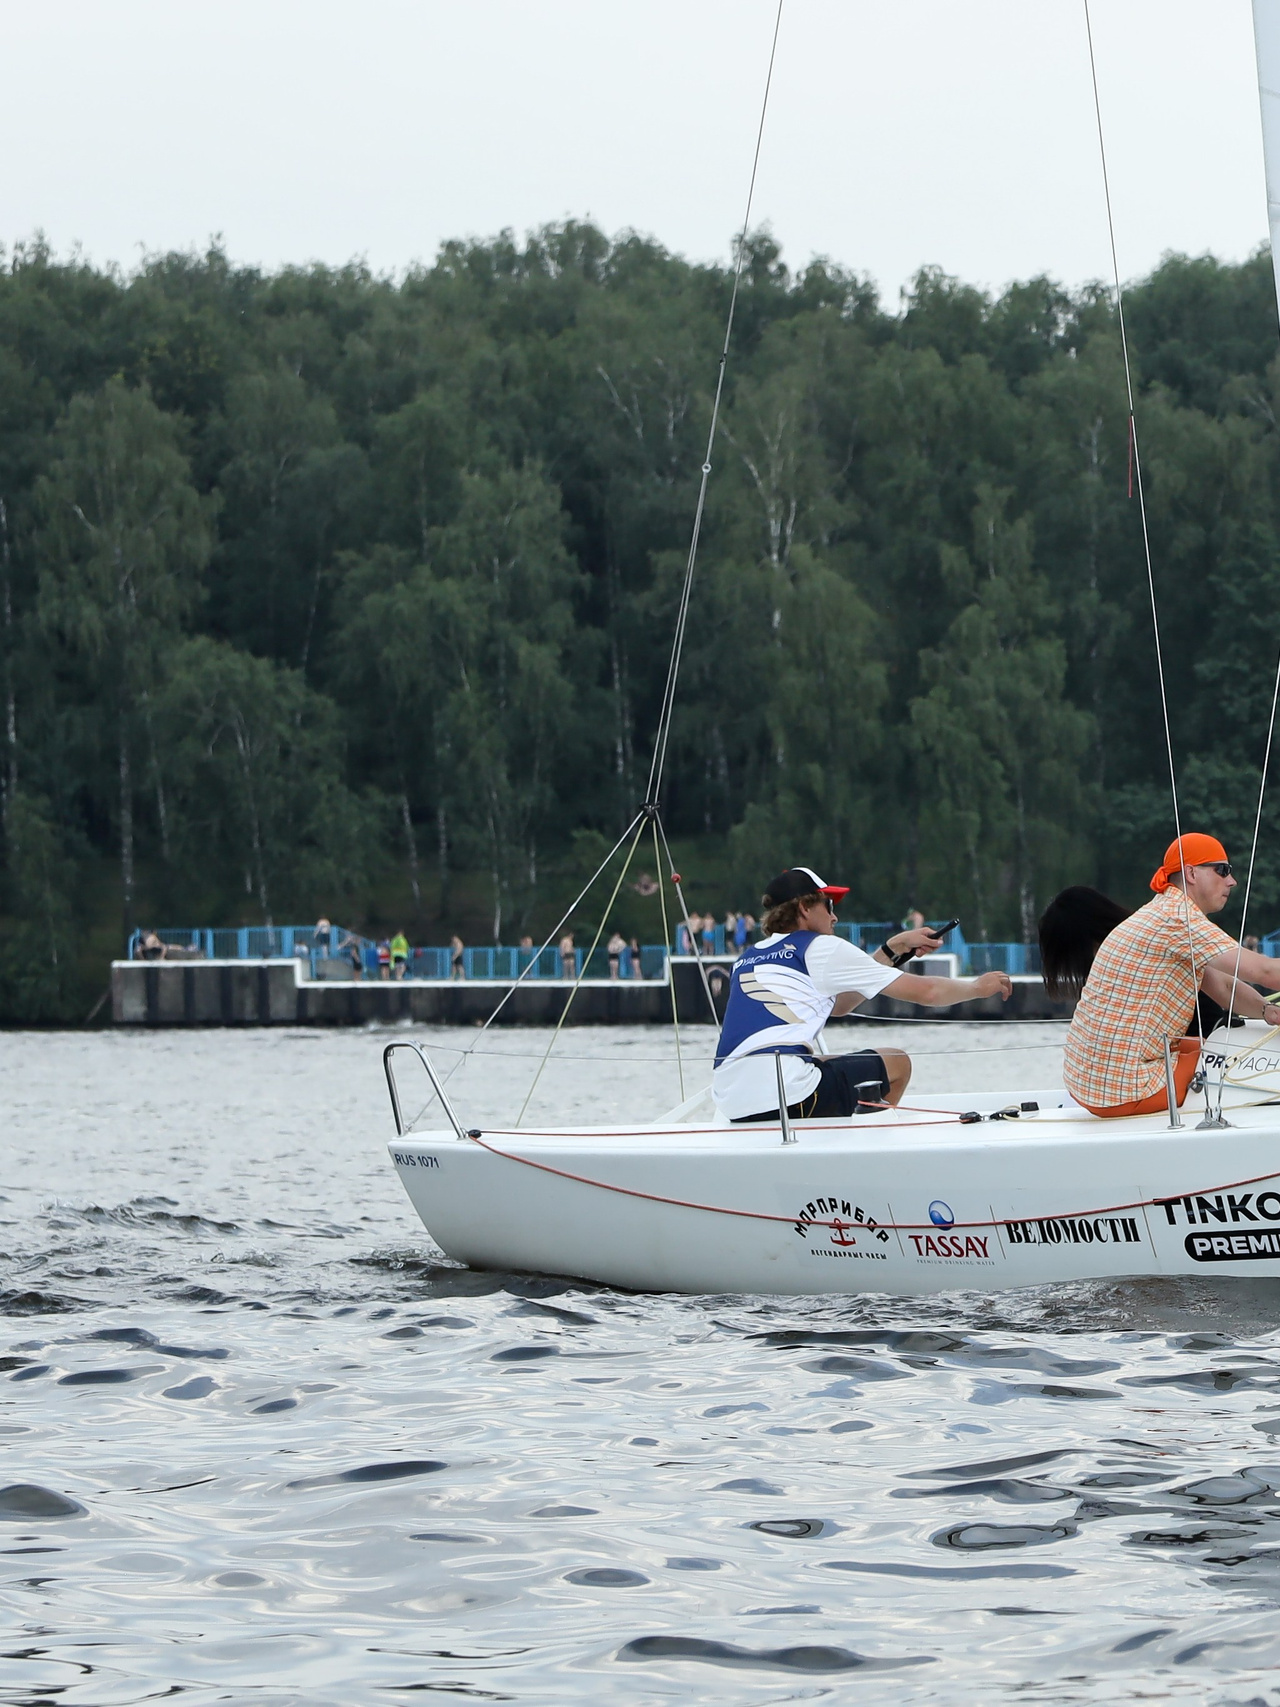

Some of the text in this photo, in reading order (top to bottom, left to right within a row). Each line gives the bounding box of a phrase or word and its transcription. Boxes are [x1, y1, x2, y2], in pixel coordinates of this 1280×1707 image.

[394, 1153, 440, 1168] RUS 1071
[794, 1197, 890, 1243] МОРПРИБОР
[1003, 1217, 1142, 1247] ВЕДОМОСТИ
[908, 1235, 990, 1258] TASSAY
